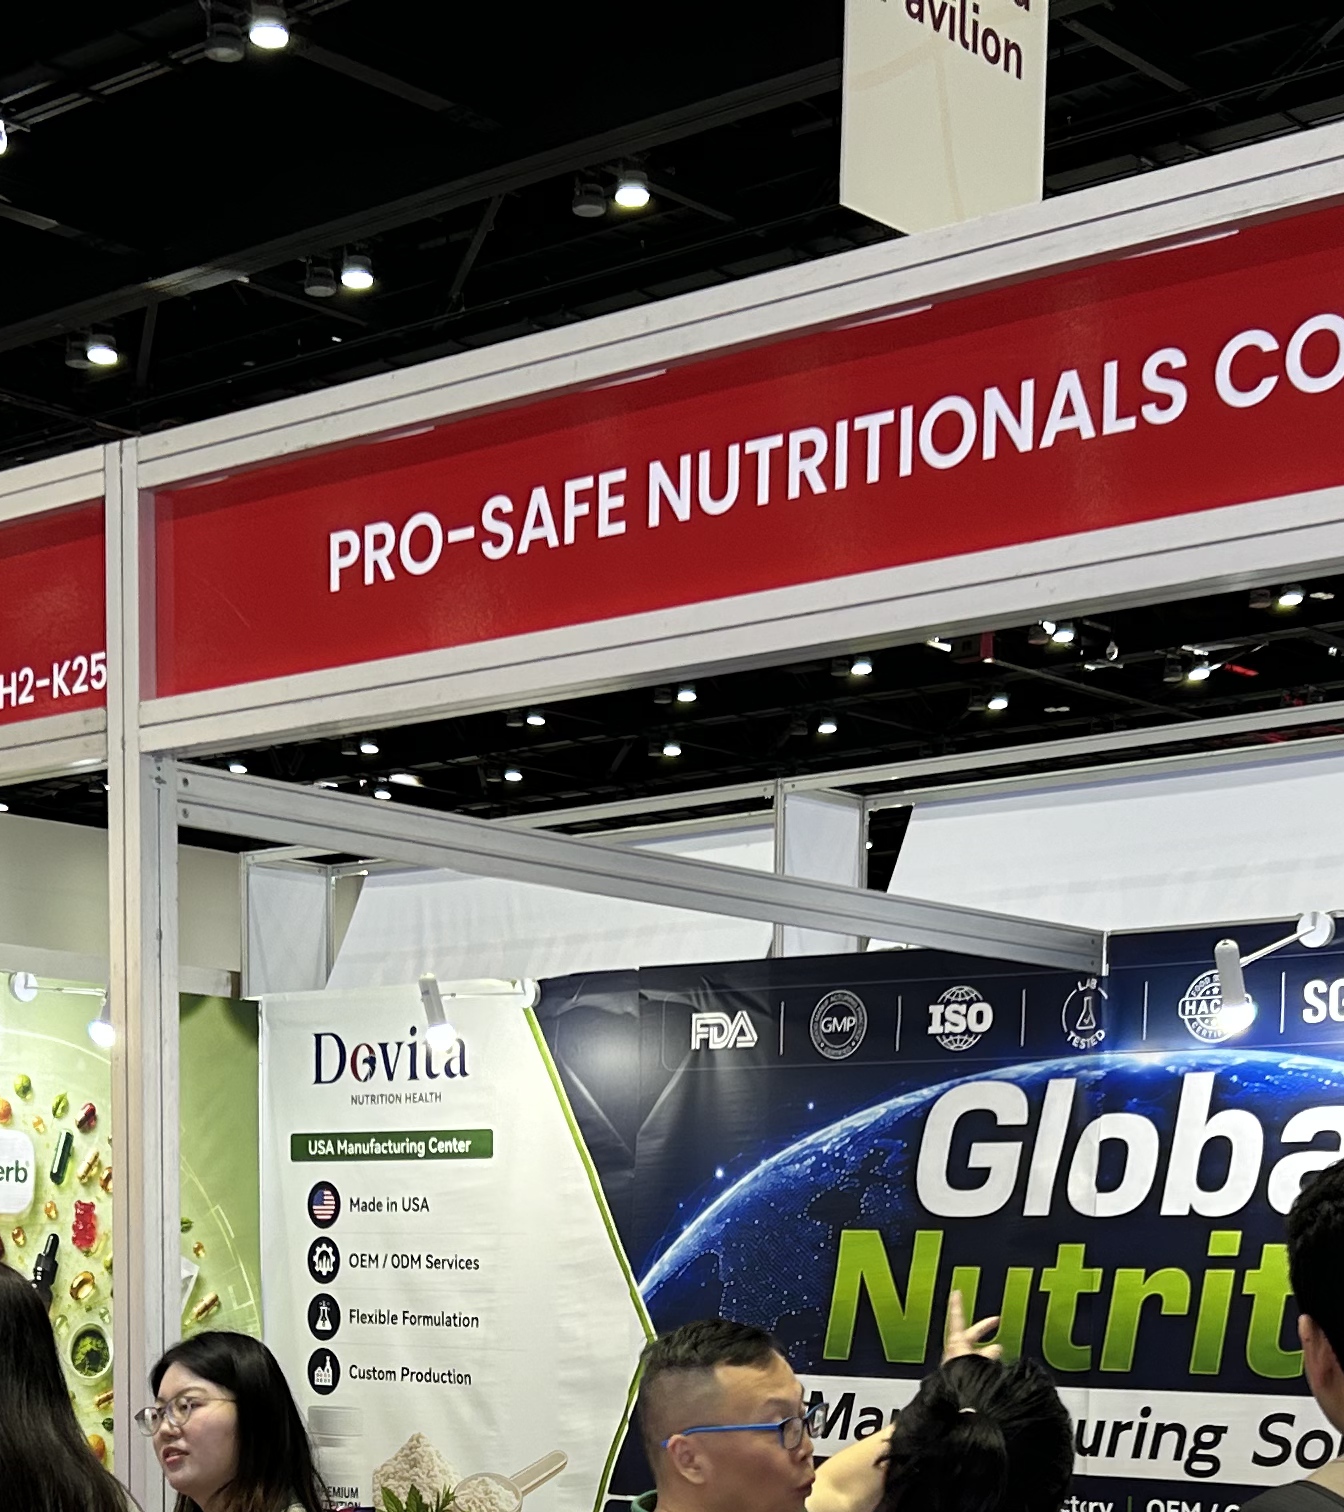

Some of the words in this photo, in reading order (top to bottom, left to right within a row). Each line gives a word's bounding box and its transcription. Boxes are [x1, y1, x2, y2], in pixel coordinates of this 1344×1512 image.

[882, 0, 1022, 80] avilion
[330, 468, 627, 592] PRO-SAFE
[648, 347, 1188, 527] NUTRITIONALS
[1183, 999, 1222, 1015] HAC
[821, 1016, 856, 1033] GMP
[927, 1001, 994, 1036] ISO
[691, 1010, 758, 1051] FDA
[1065, 1030, 1108, 1050] TESTED
[350, 1093, 403, 1106] NUTRITION
[404, 1091, 442, 1105] HEALTH
[308, 1140, 335, 1156] USA
[337, 1138, 426, 1159] Manufacturing
[428, 1137, 472, 1156] Center
[349, 1197, 383, 1213] Made
[386, 1198, 398, 1213] in
[401, 1197, 430, 1213] USA
[348, 1254, 380, 1270] OEM
[390, 1254, 422, 1270] ODM
[425, 1254, 480, 1272] Services
[348, 1309, 399, 1328] Flexible
[402, 1311, 480, 1330] Formulation
[348, 1364, 397, 1383] Custom
[401, 1366, 472, 1387] Production
